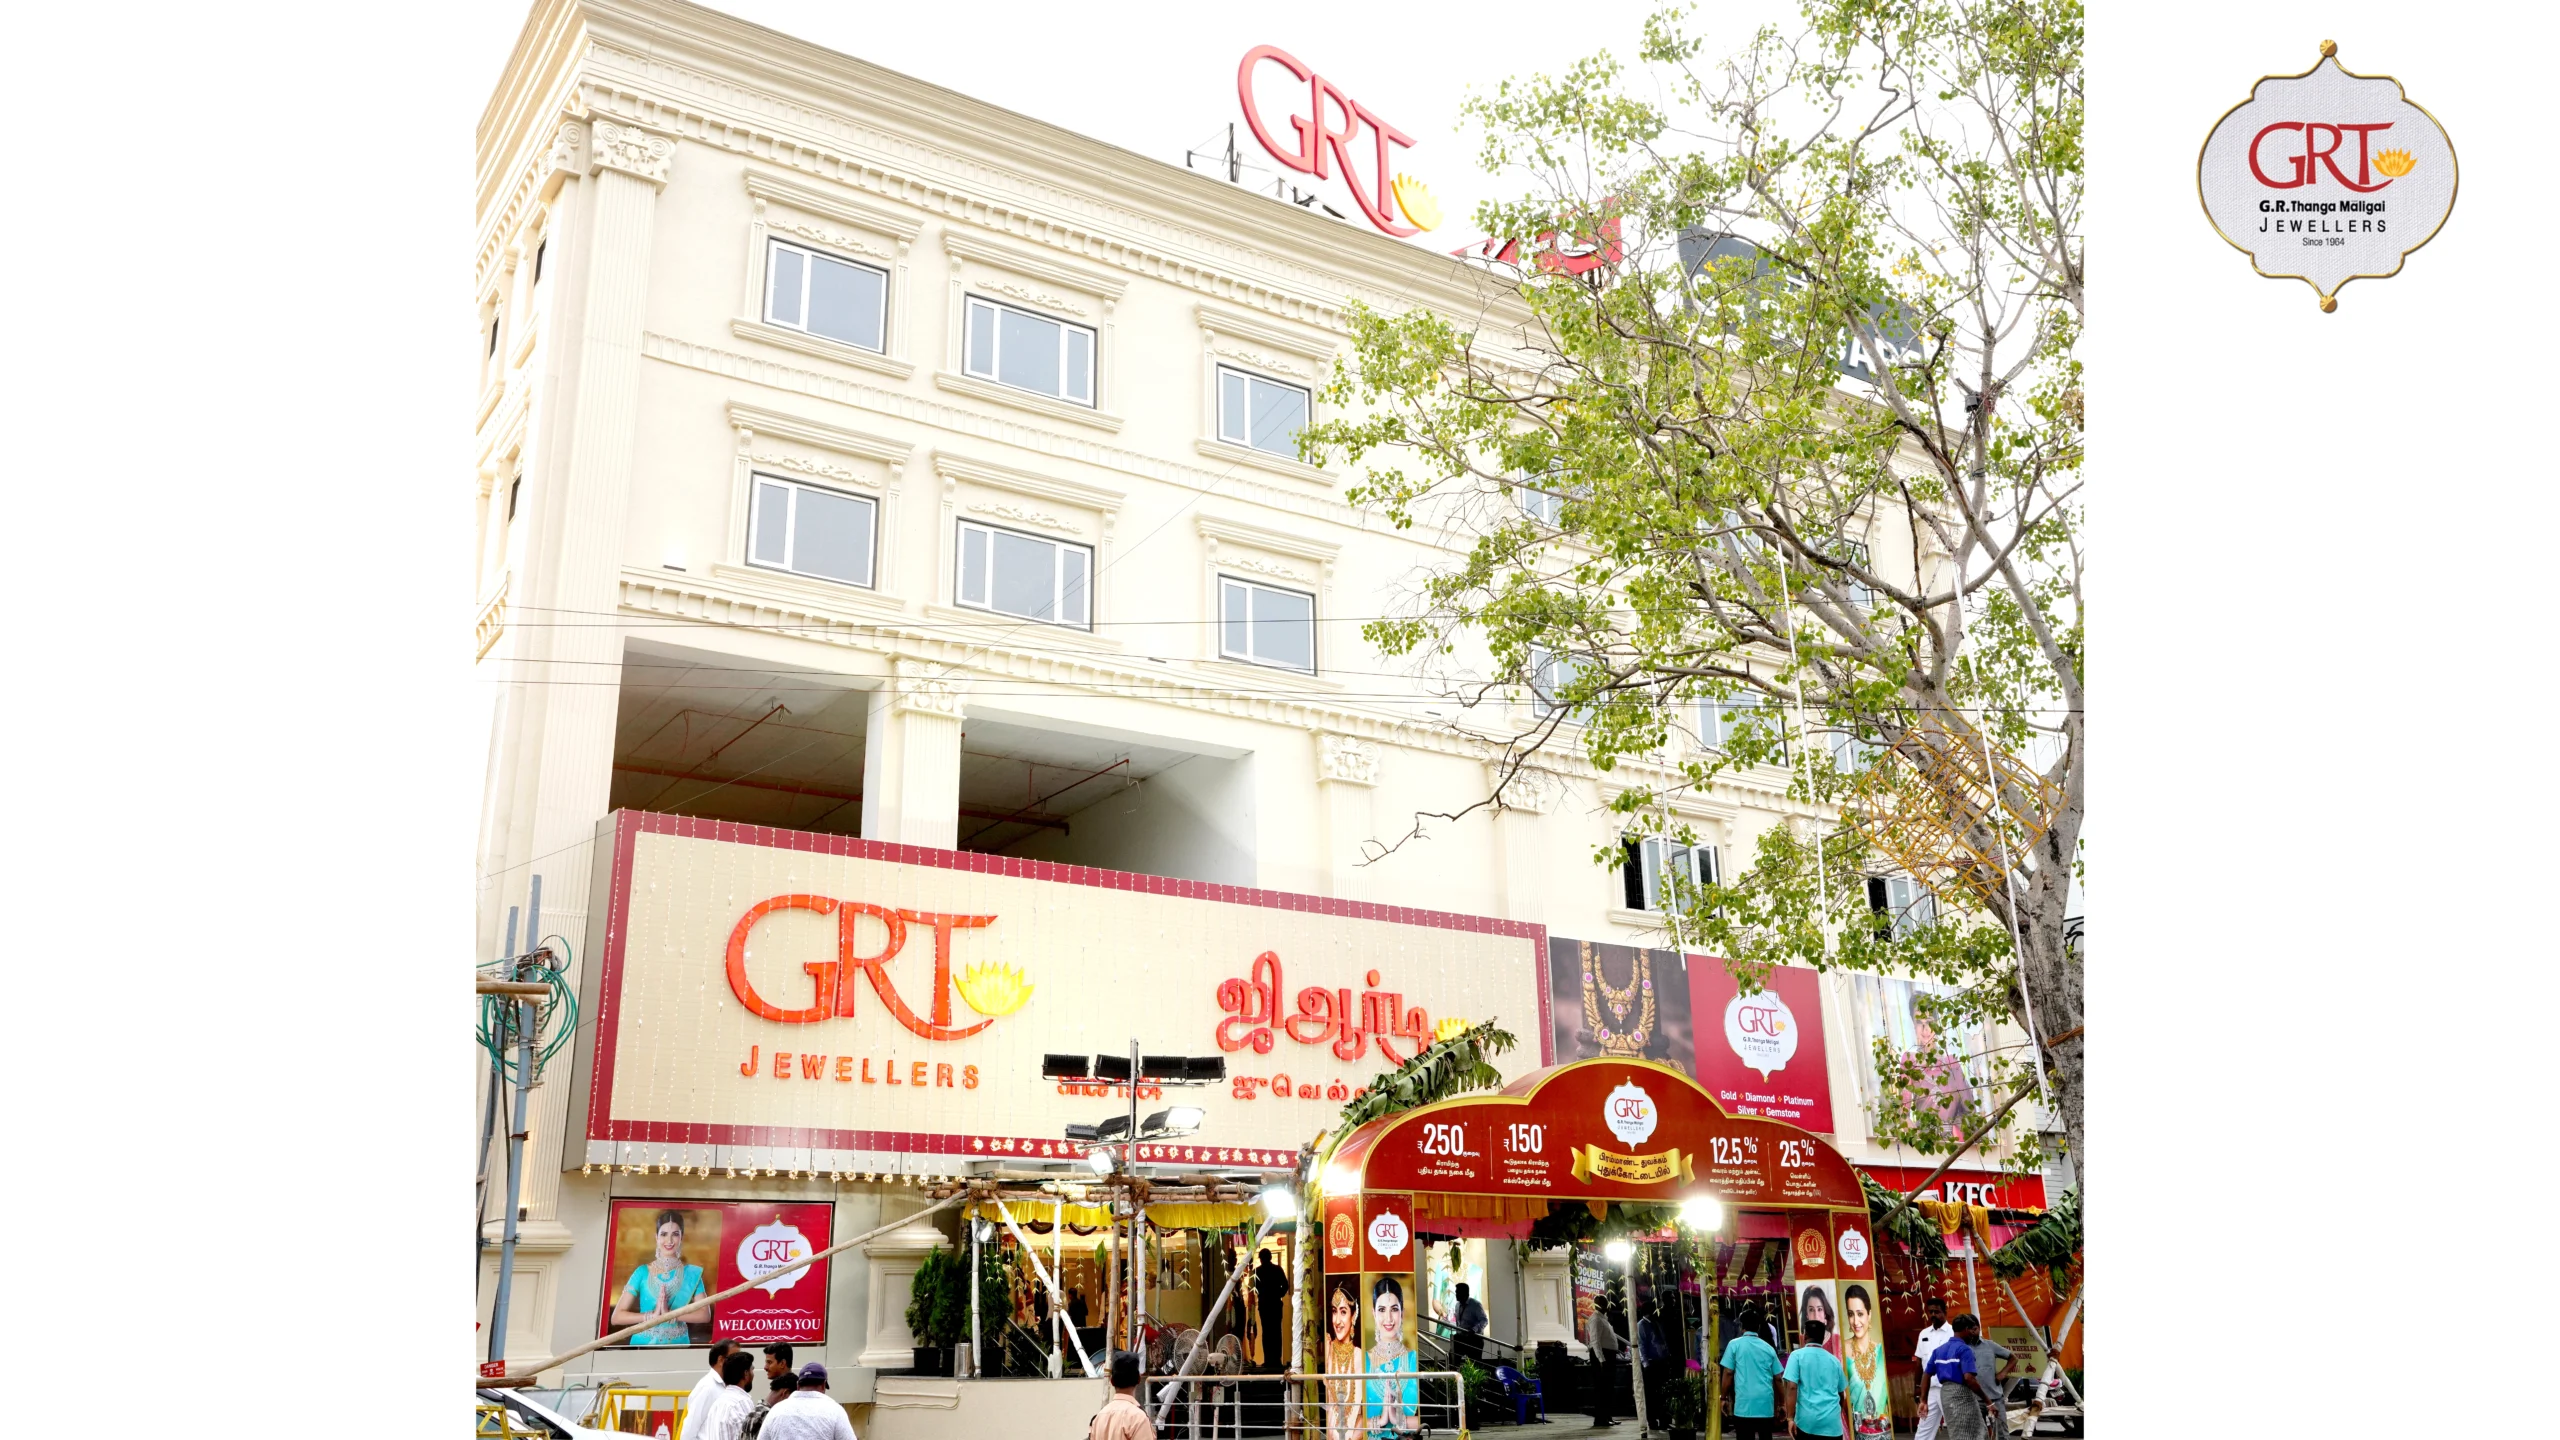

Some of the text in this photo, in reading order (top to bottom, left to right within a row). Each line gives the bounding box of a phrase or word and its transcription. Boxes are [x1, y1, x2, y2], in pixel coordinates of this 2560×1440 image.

[1237, 44, 1419, 238] GRT
[725, 893, 998, 1042] GRT
[1738, 1005, 1781, 1037] GRT
[740, 1045, 980, 1089] JEWELLERS
[1720, 1089, 1814, 1106] Gold Diamond Platinum
[1614, 1098, 1645, 1120] GRT
[1737, 1105, 1801, 1118] Silver Gemstone
[1599, 1152, 1639, 1167] பிரம்மாண்ட
[1597, 1164, 1670, 1180] புதுக்கோட்டையில்
[1945, 1181, 1997, 1209] KFC
[1335, 1223, 1349, 1241] 60
[1375, 1223, 1399, 1239] GRT
[752, 1239, 796, 1263] GRT
[1804, 1237, 1819, 1253] 60
[1581, 1250, 1601, 1264] KFC
[1578, 1266, 1604, 1281] DOUBLE
[1574, 1276, 1605, 1291] CHICKEN
[718, 1318, 821, 1331] WELCOMES YOU
[2007, 1337, 2018, 1345] WAY
